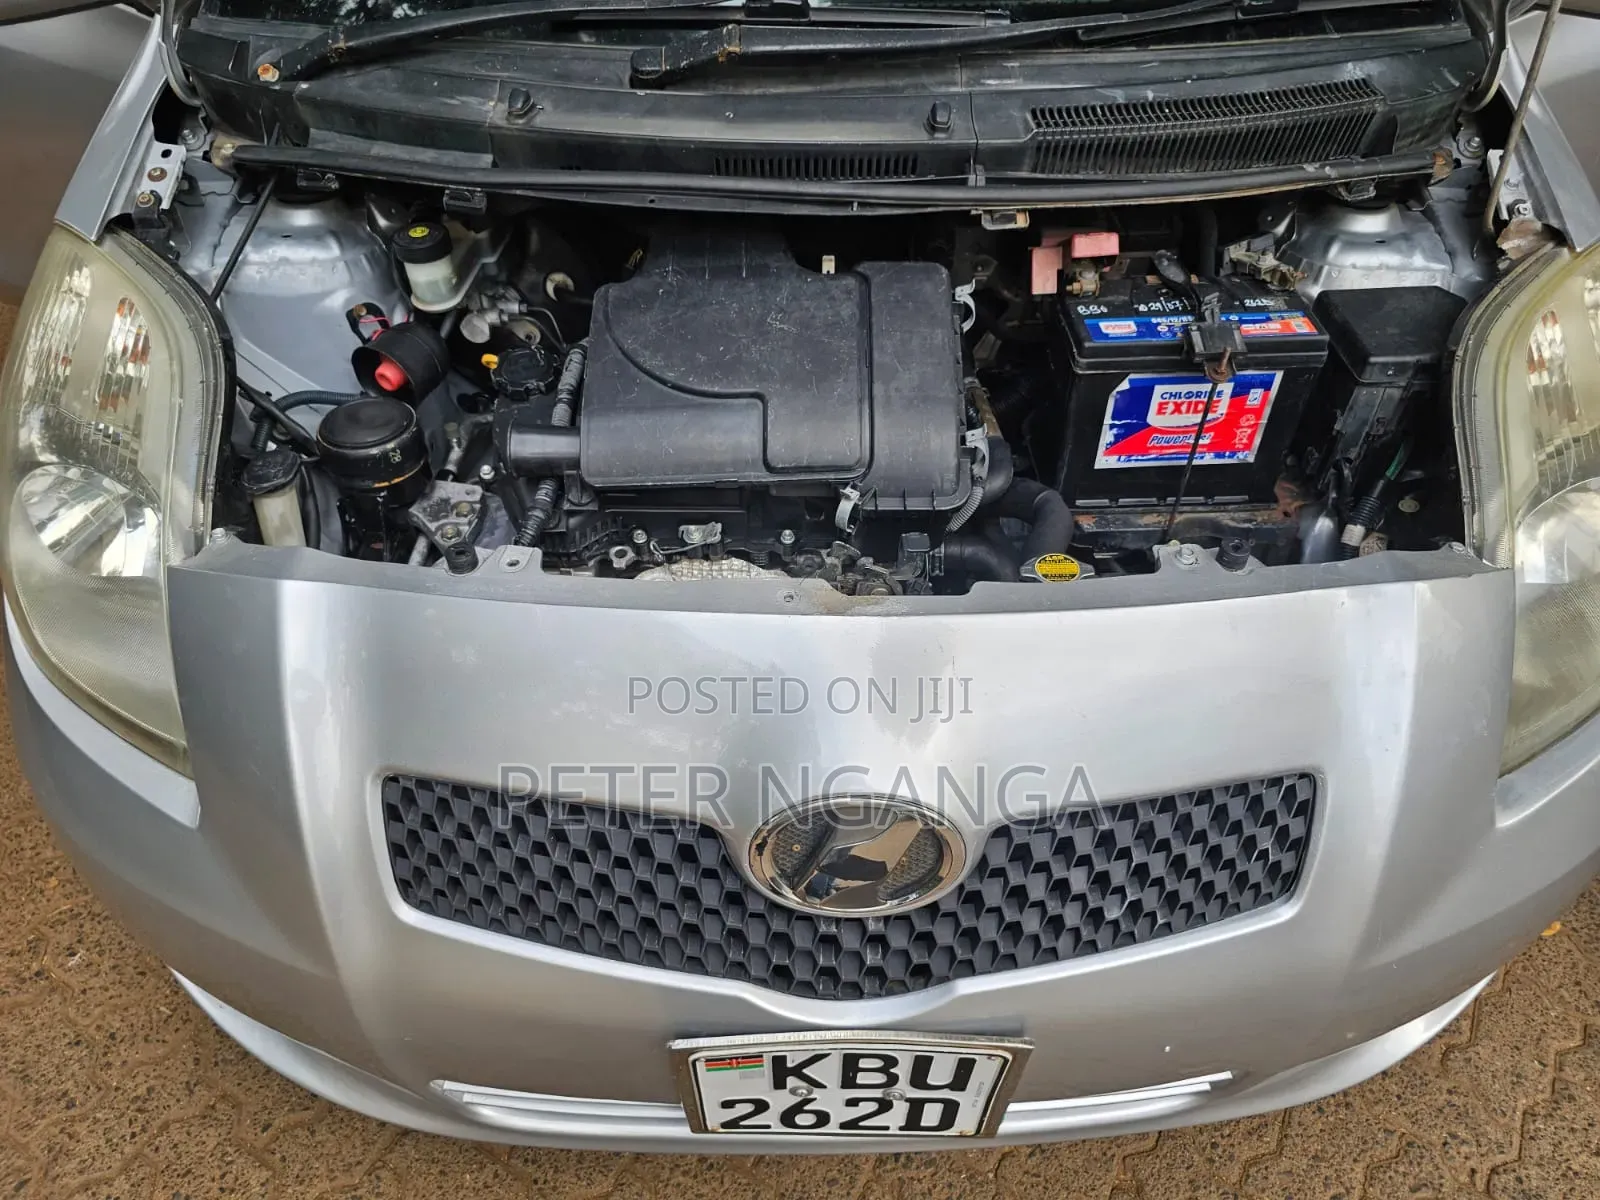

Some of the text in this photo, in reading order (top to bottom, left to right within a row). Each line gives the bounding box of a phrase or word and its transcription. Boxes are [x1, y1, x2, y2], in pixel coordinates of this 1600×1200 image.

[1156, 399, 1222, 416] EXIDE
[1160, 390, 1225, 400] CHLORIE
[771, 1052, 977, 1092] KBU
[719, 1097, 960, 1132] 262D
